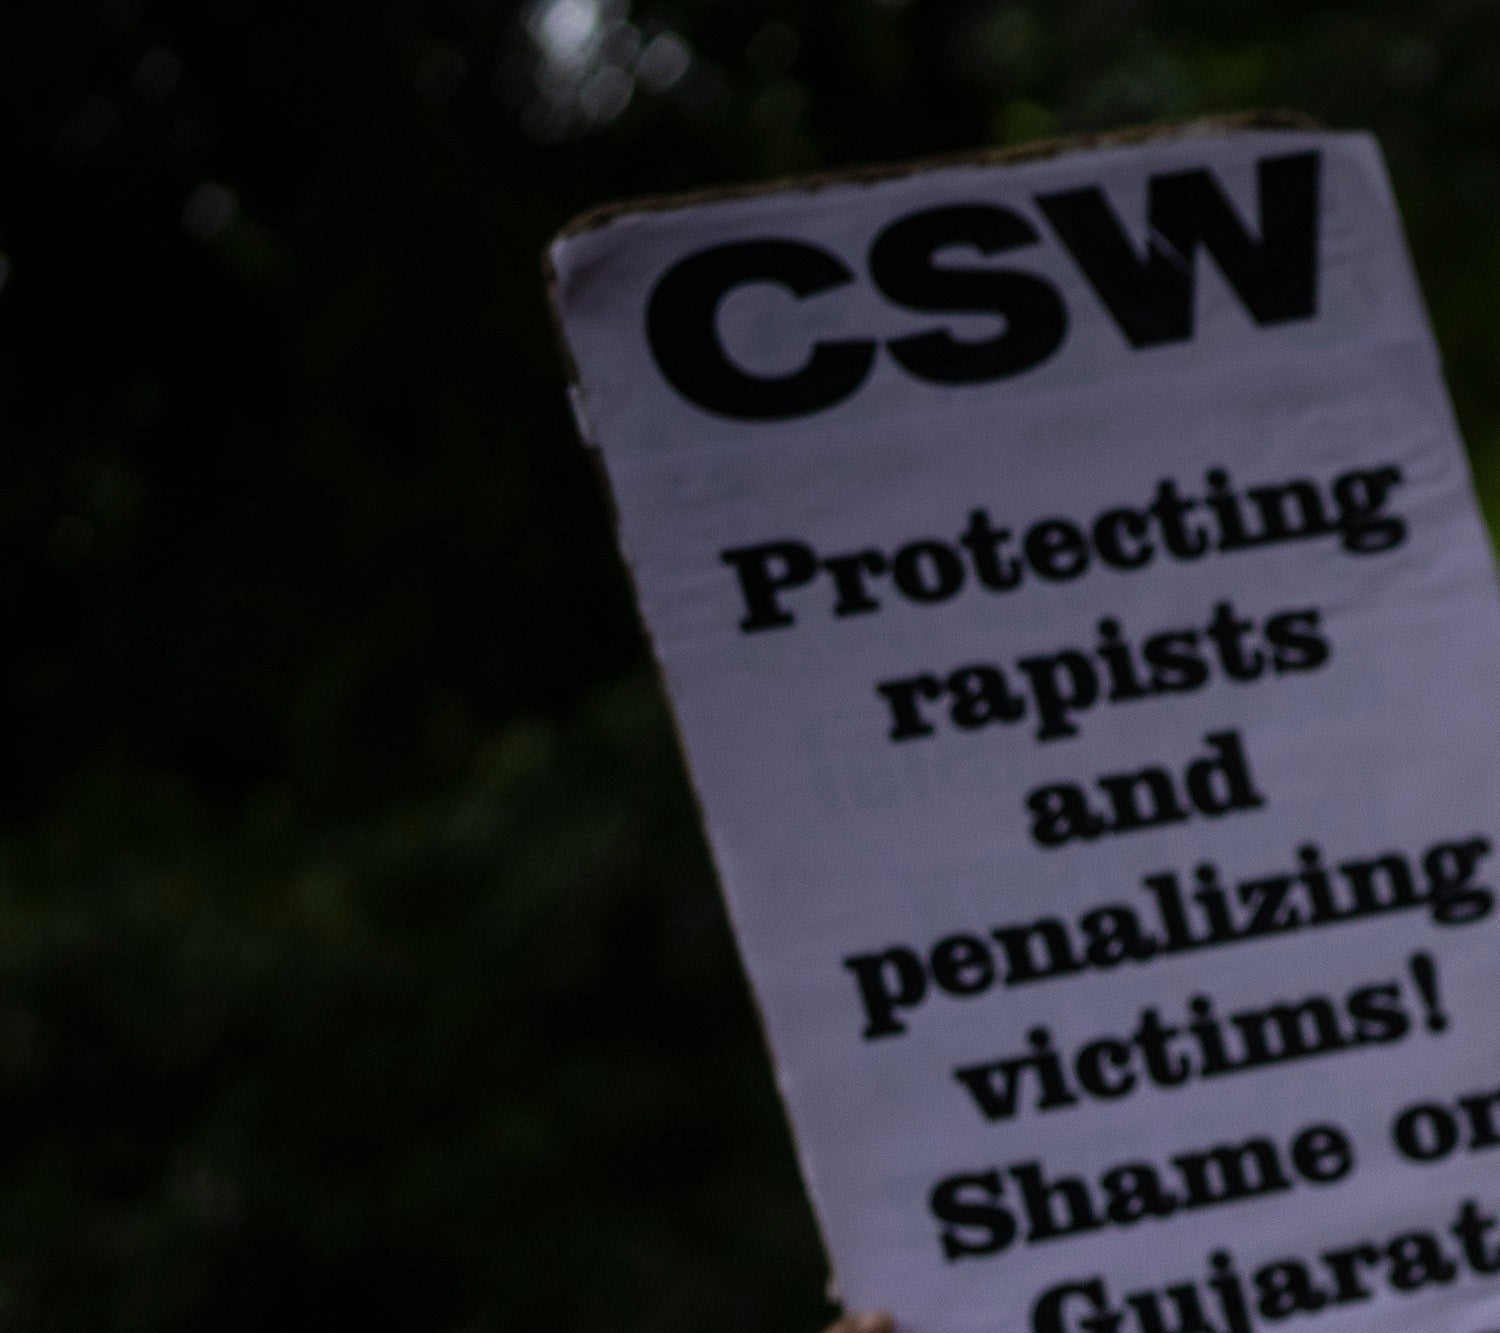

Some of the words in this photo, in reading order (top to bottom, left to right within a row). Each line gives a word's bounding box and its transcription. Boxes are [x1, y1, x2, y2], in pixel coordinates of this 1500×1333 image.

[645, 148, 1322, 422] CSW
[719, 466, 1406, 634] Protecting
[876, 602, 1329, 743] rapists
[1025, 730, 1264, 849] and
[843, 837, 1495, 1041] penalizing
[953, 952, 1447, 1122] victims!
[929, 1125, 1354, 1262] Shame
